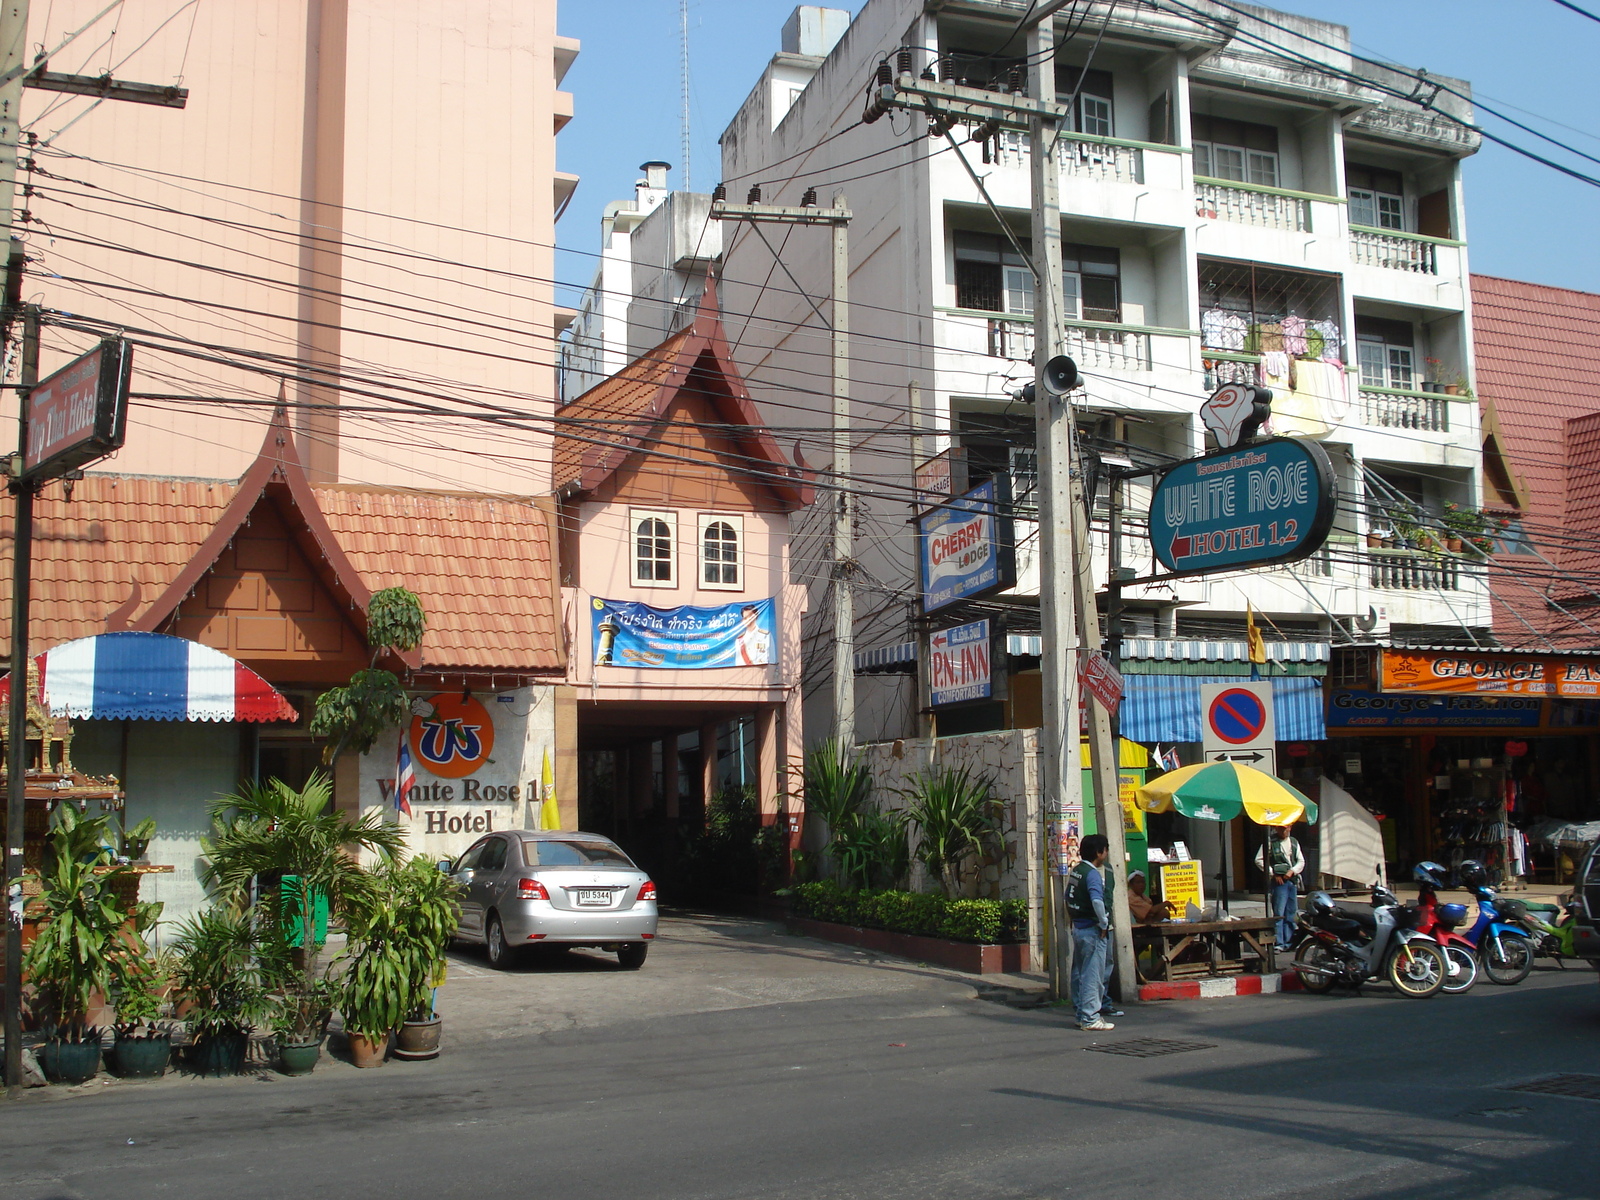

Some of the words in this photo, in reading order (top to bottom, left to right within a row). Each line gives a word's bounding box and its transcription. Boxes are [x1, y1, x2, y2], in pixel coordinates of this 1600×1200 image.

[46, 396, 67, 448] Thai
[67, 379, 99, 436] Hotel
[1164, 474, 1235, 528] WHITE
[1248, 460, 1308, 513] ROSE
[931, 518, 983, 566] CHERRY
[1193, 524, 1265, 557] HOTEL
[1268, 518, 1299, 546] 1,2
[958, 542, 988, 569] LODGE
[933, 648, 959, 689] P.N.
[961, 641, 989, 685] INN
[1432, 657, 1545, 681] GEORGE
[937, 684, 985, 704] COMFORTABLE
[1334, 693, 1430, 713] George
[1347, 717, 1388, 725] LADIES
[461, 779, 521, 802] Rose
[527, 779, 540, 802] 1
[425, 810, 493, 834] Hotel
[592, 891, 609, 899] 5344
